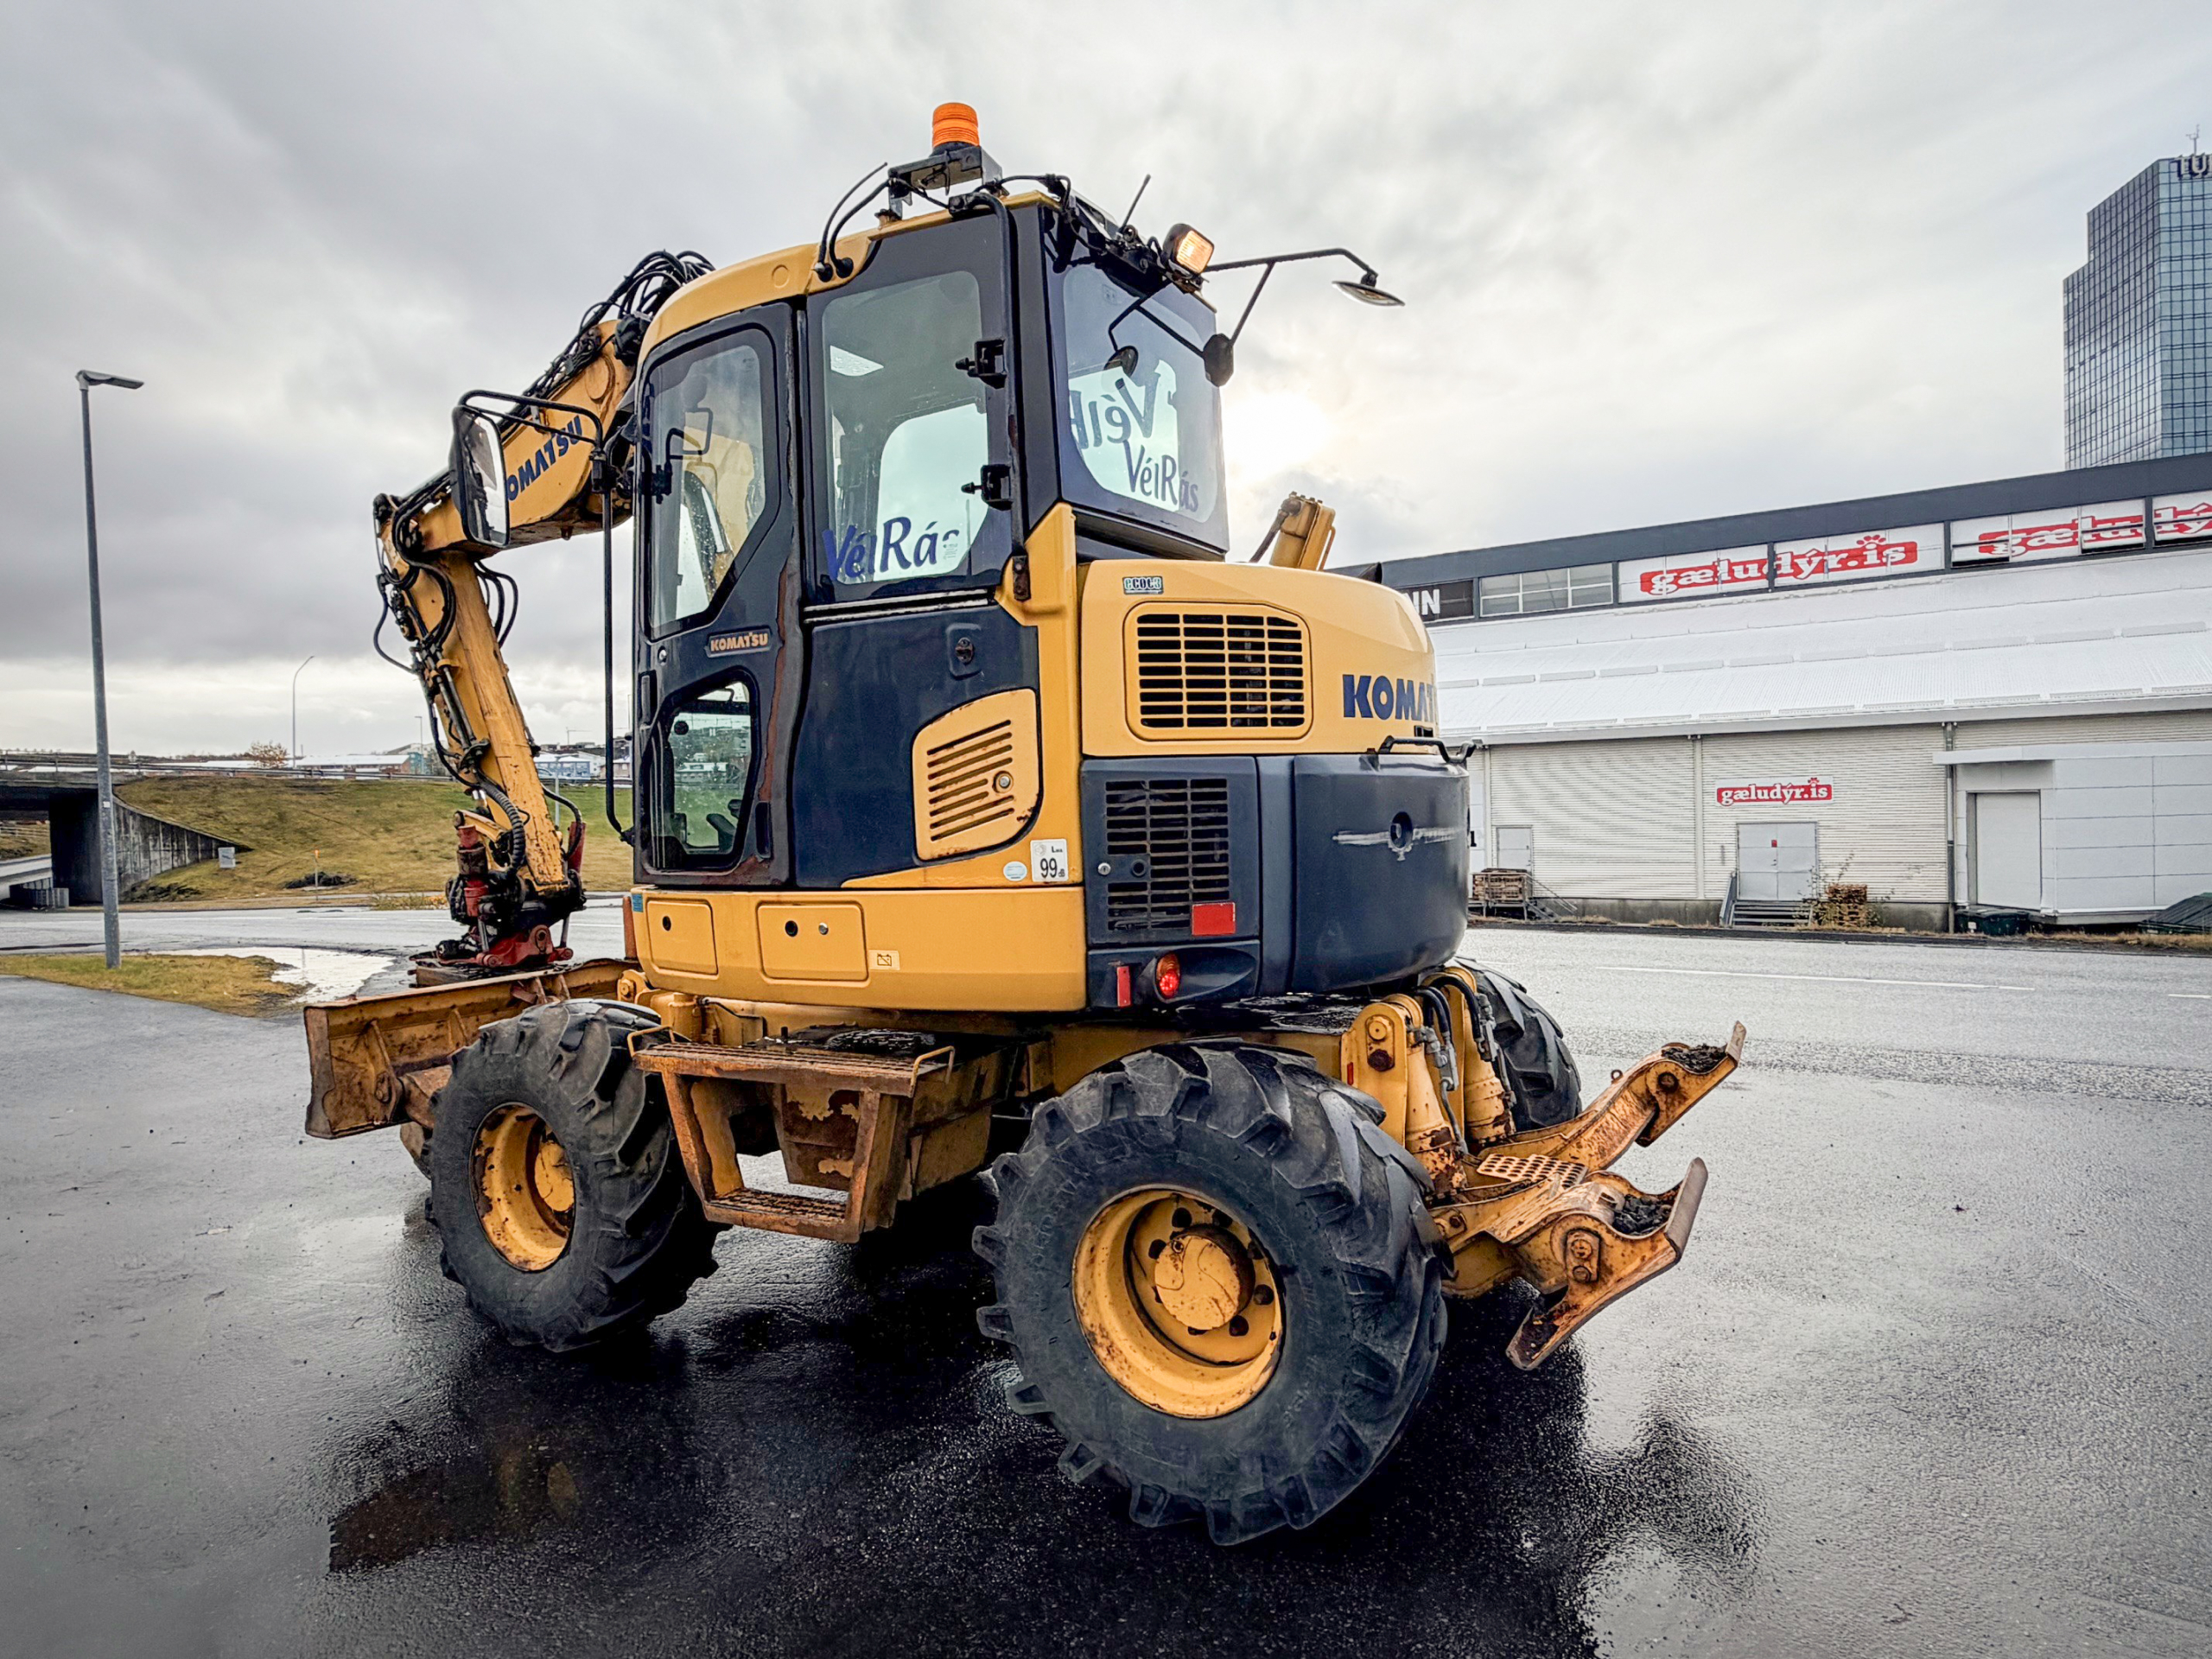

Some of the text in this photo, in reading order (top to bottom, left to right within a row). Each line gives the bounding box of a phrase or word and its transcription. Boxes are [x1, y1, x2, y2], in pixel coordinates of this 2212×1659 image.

[506, 415, 582, 501] OMATSU
[1123, 440, 1198, 512] VélRás
[1651, 543, 1906, 595] gæludýr.is
[710, 632, 769, 652] KOMATSU
[1342, 674, 1435, 722] KOMAT
[1721, 782, 1828, 805] gæludýr.is
[1039, 857, 1058, 878] 99
